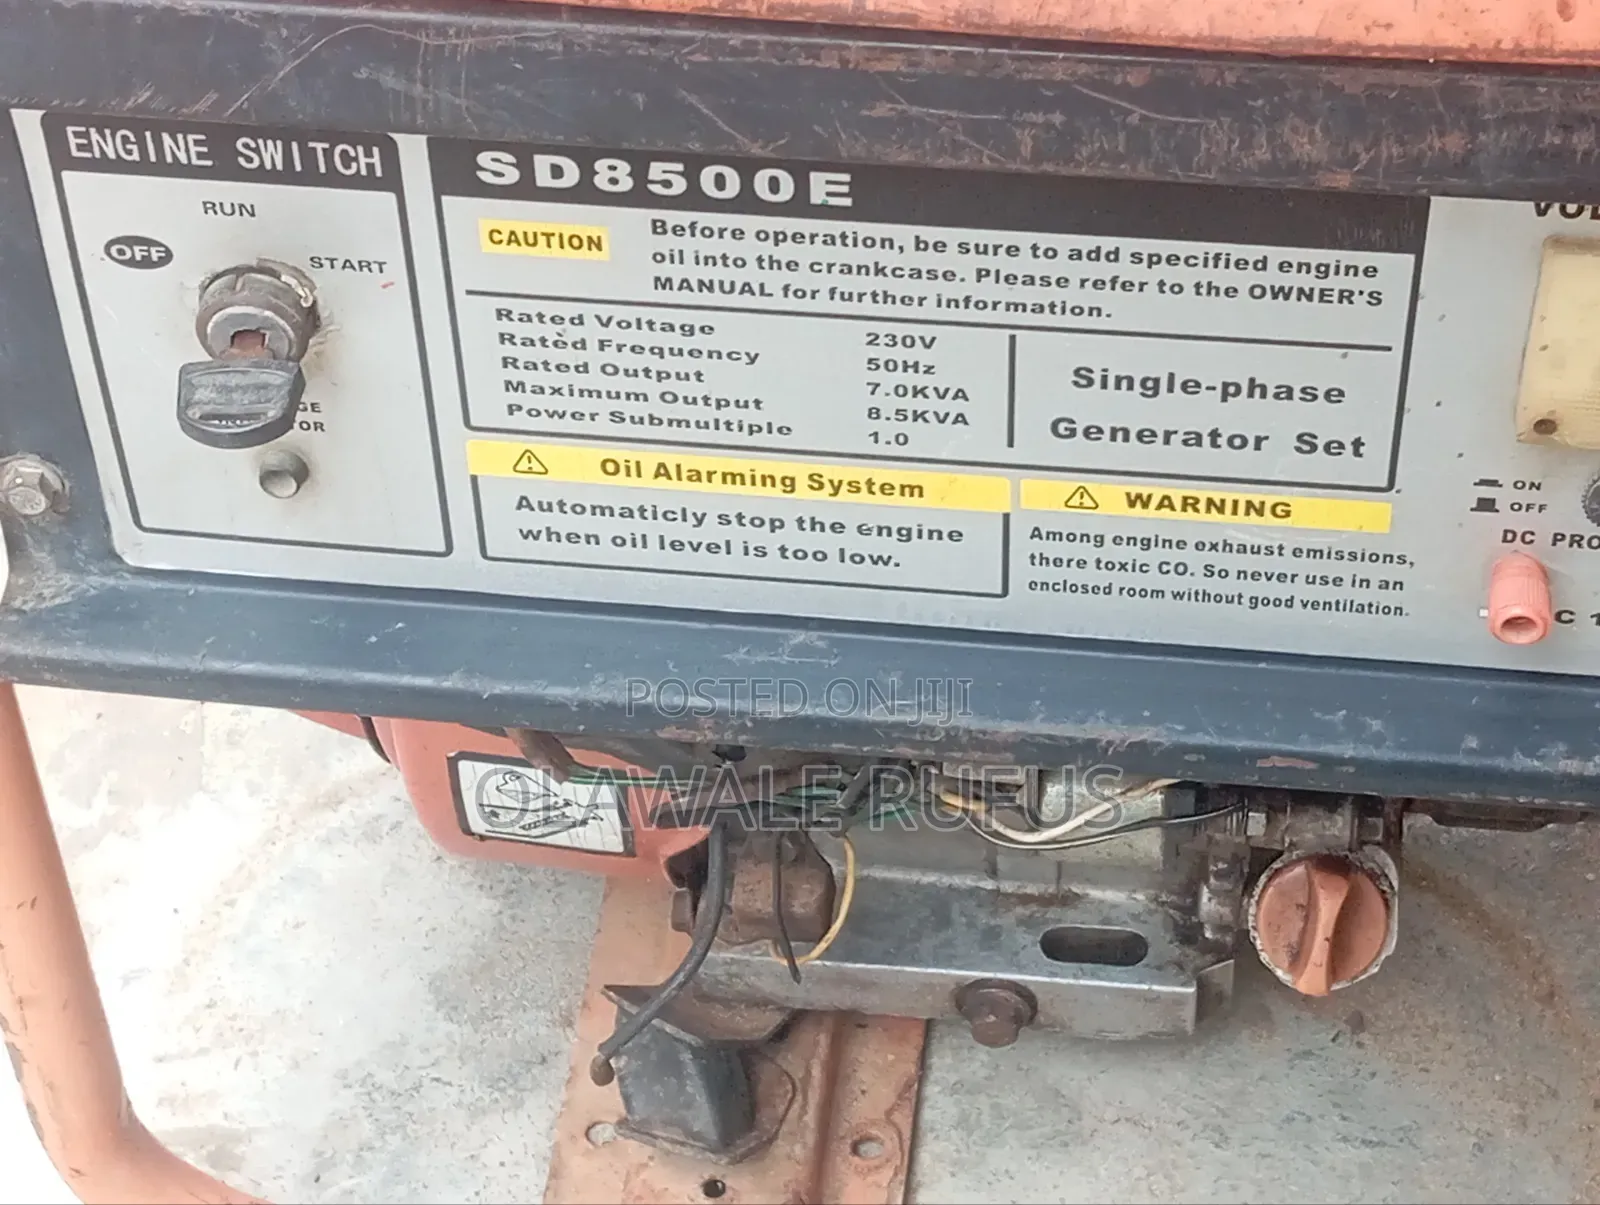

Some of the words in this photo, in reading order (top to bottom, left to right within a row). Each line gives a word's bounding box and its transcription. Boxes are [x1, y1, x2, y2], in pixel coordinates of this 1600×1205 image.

[65, 125, 213, 167] ENGINE
[235, 137, 383, 178] SWITCH
[475, 150, 853, 207] SD8500E
[202, 200, 257, 218] RUN
[109, 244, 168, 263] OFF
[488, 228, 603, 252] CAUTION
[650, 218, 745, 241] Before
[755, 228, 904, 254] operation,
[914, 235, 948, 253] be
[957, 241, 1021, 257] sure
[1030, 242, 1058, 260] to
[1068, 246, 1120, 263] add
[1129, 251, 1268, 272] specified
[1278, 258, 1379, 280] engine
[309, 256, 387, 274] START
[652, 249, 685, 265] oil
[694, 250, 747, 270] into
[756, 254, 800, 272] the
[809, 260, 966, 283] crankcase.
[976, 267, 1070, 289] Please
[1079, 275, 1149, 293] refer
[1157, 279, 1184, 296] to
[1193, 281, 1239, 298] the
[1248, 283, 1383, 307] OWNER'S
[653, 276, 774, 298] MANUAL
[782, 284, 820, 300] for
[828, 286, 928, 308] further
[936, 293, 1112, 318] information.
[495, 308, 585, 327] Rated
[594, 314, 715, 337] Voltage
[865, 332, 937, 350] 230V
[498, 332, 587, 351] Rated
[597, 338, 760, 365] Frequency
[866, 358, 936, 375] 50Hz
[501, 356, 589, 375] Rated
[600, 363, 705, 383] Output
[866, 382, 969, 402] 7.0KVA
[1071, 365, 1348, 405] Single-phase
[504, 380, 649, 403] Maximum
[659, 391, 764, 412] Output
[867, 407, 970, 426] 8.5KVA
[507, 404, 600, 423] Power
[609, 410, 793, 437] Submultiple
[868, 431, 909, 446] 1.0
[1049, 416, 1270, 452] Generator
[1293, 432, 1366, 459] Set
[600, 458, 642, 478] Oil
[653, 462, 796, 494] Alarming
[807, 472, 924, 498] System
[1513, 480, 1542, 491] ON
[515, 495, 707, 528] Automaticly
[717, 511, 785, 533] stop
[796, 515, 846, 534] the
[857, 523, 964, 543] engine
[1125, 492, 1292, 518] WARNING
[1509, 502, 1548, 513] OFF
[519, 526, 600, 545] when
[611, 532, 648, 549] oil
[658, 534, 732, 555] level
[743, 541, 768, 558] is
[779, 544, 828, 562] too
[838, 548, 900, 567] low.
[1029, 526, 1105, 547] Among
[1112, 534, 1187, 551] engine
[1194, 539, 1285, 557] exhaust
[1292, 546, 1415, 568] emissions,
[1501, 529, 1536, 545] DC
[1029, 553, 1087, 569] there
[1095, 559, 1150, 574] toxic
[1158, 561, 1195, 577] CO.
[1203, 564, 1229, 580] So
[1236, 569, 1299, 584] never
[1305, 574, 1343, 587] use
[1351, 574, 1371, 589] in
[1378, 579, 1404, 591] an
[1028, 580, 1113, 596] enclosed
[1119, 586, 1165, 599] room
[1171, 588, 1243, 606] without
[1249, 596, 1295, 610] good
[1300, 599, 1410, 616] ventilation.
